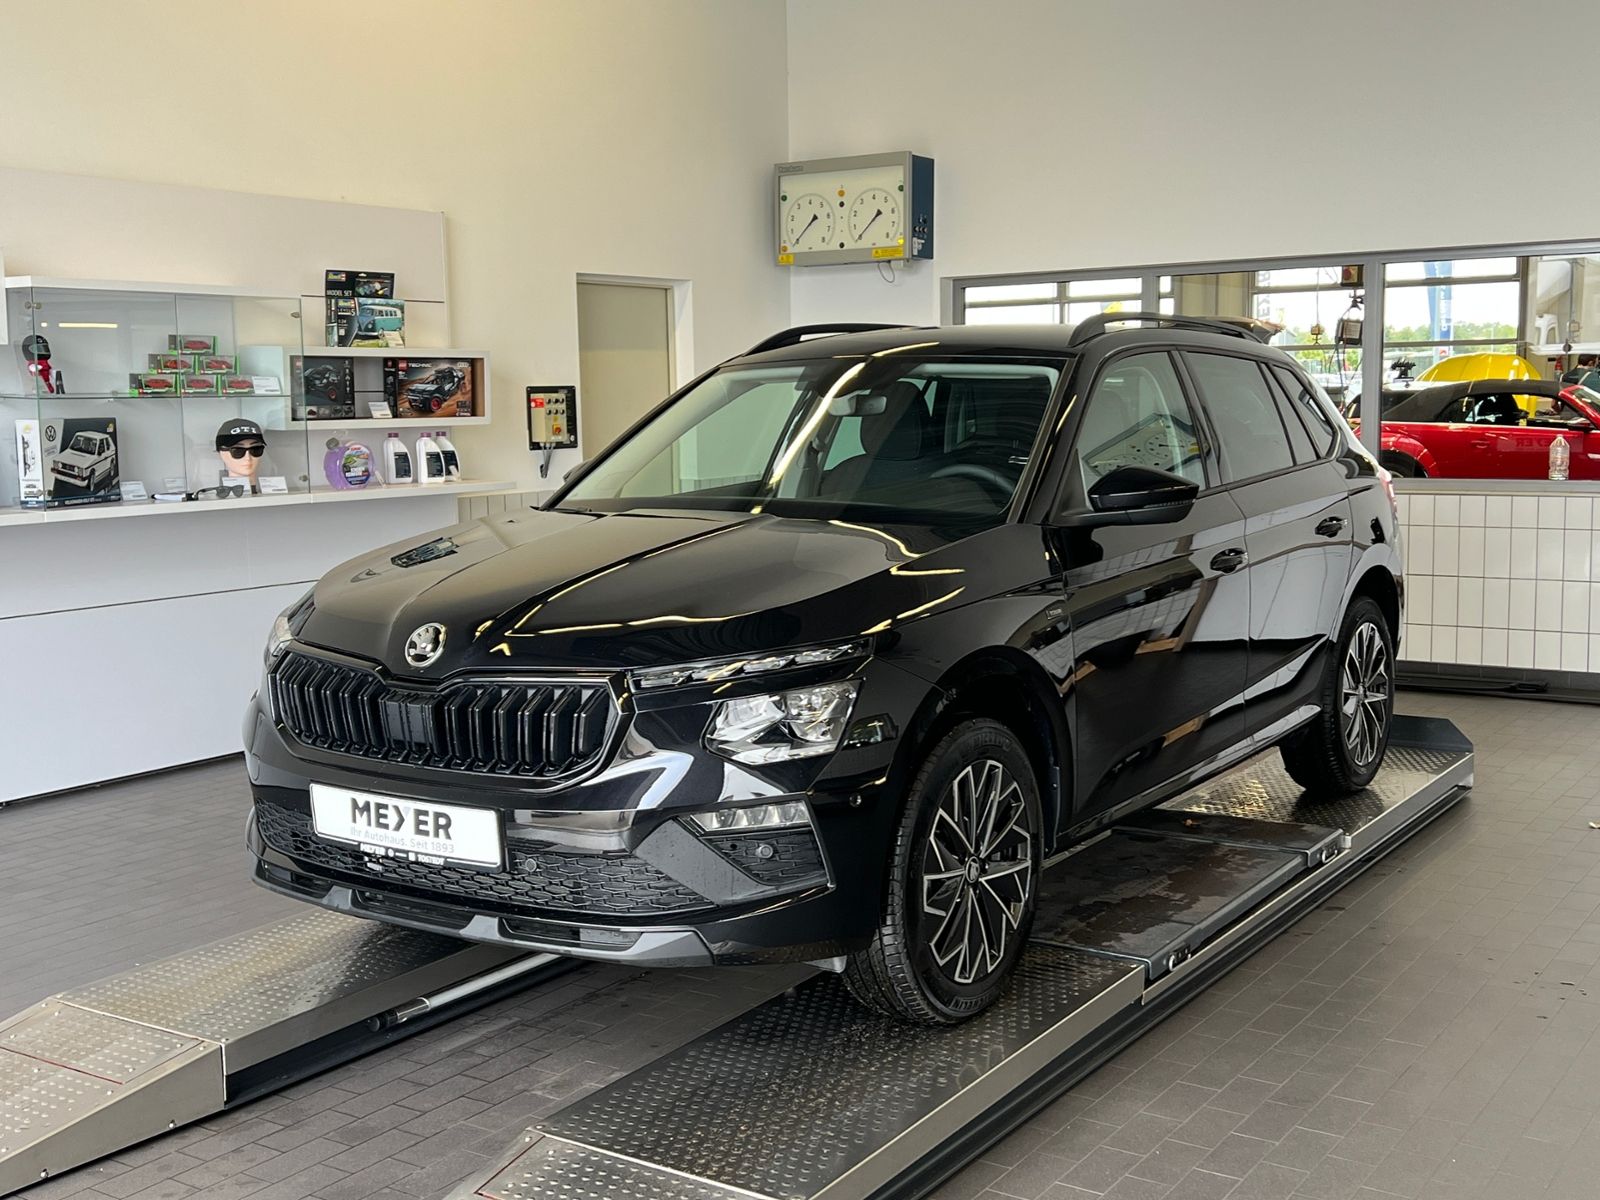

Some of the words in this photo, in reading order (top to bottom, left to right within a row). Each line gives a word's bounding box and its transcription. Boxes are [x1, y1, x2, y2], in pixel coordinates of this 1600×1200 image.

[230, 426, 257, 435] GTI
[350, 826, 362, 837] Ihr
[364, 830, 408, 846] Autohaus.
[410, 838, 428, 850] Seit
[431, 842, 455, 853] 1893
